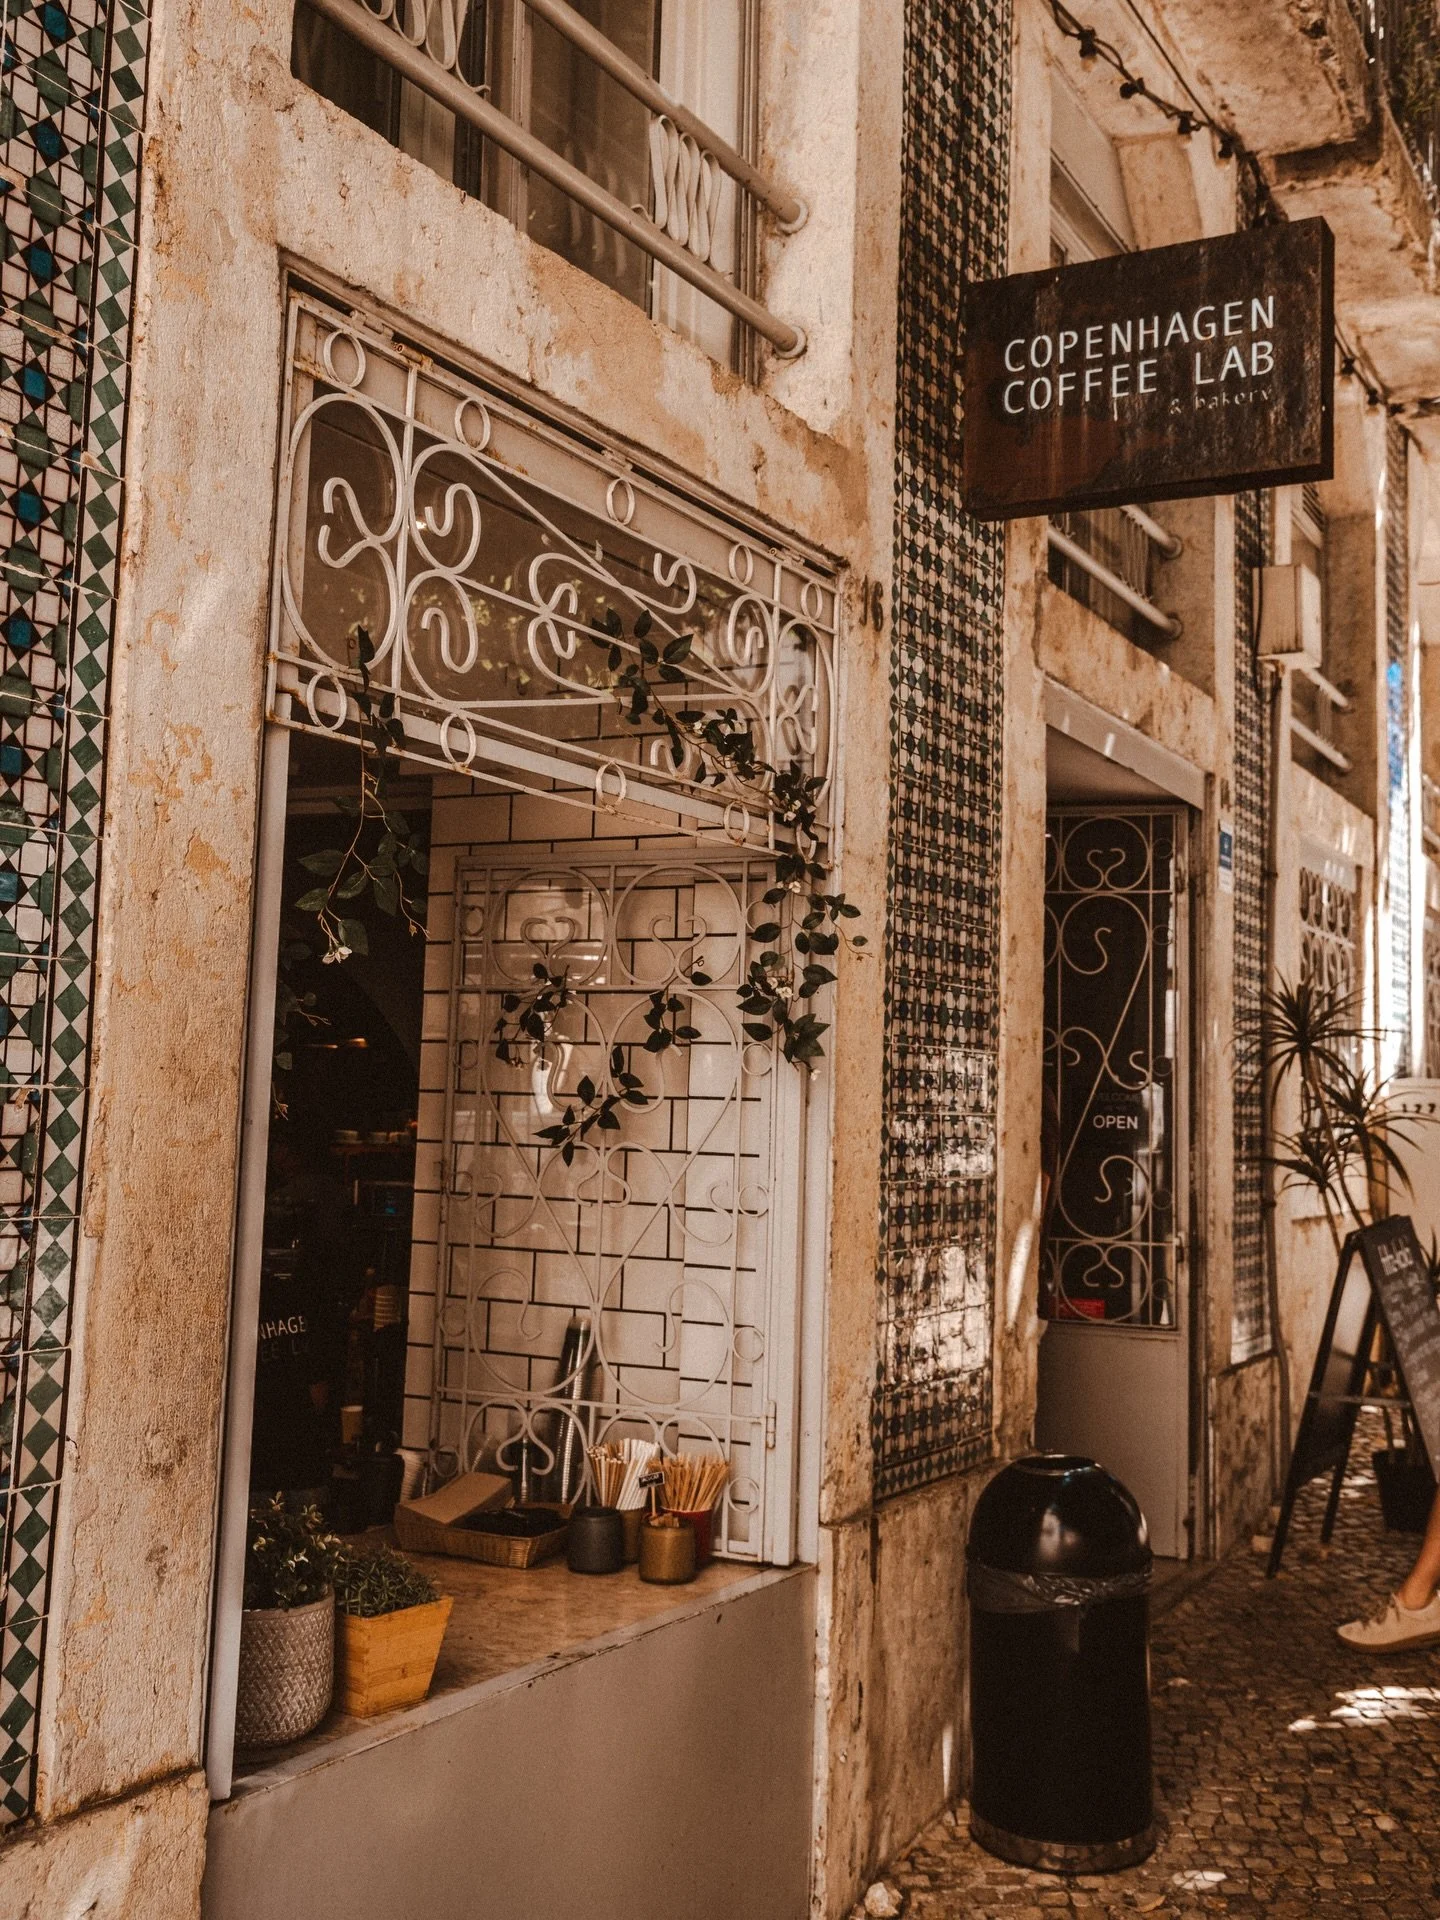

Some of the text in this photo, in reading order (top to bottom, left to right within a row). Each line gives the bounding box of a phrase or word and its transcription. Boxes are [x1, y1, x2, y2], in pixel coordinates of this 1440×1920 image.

[1004, 295, 1274, 373] COPENHAGEN
[1003, 340, 1274, 414] COFFEE LAB
[1093, 1115, 1138, 1130] OPEN
